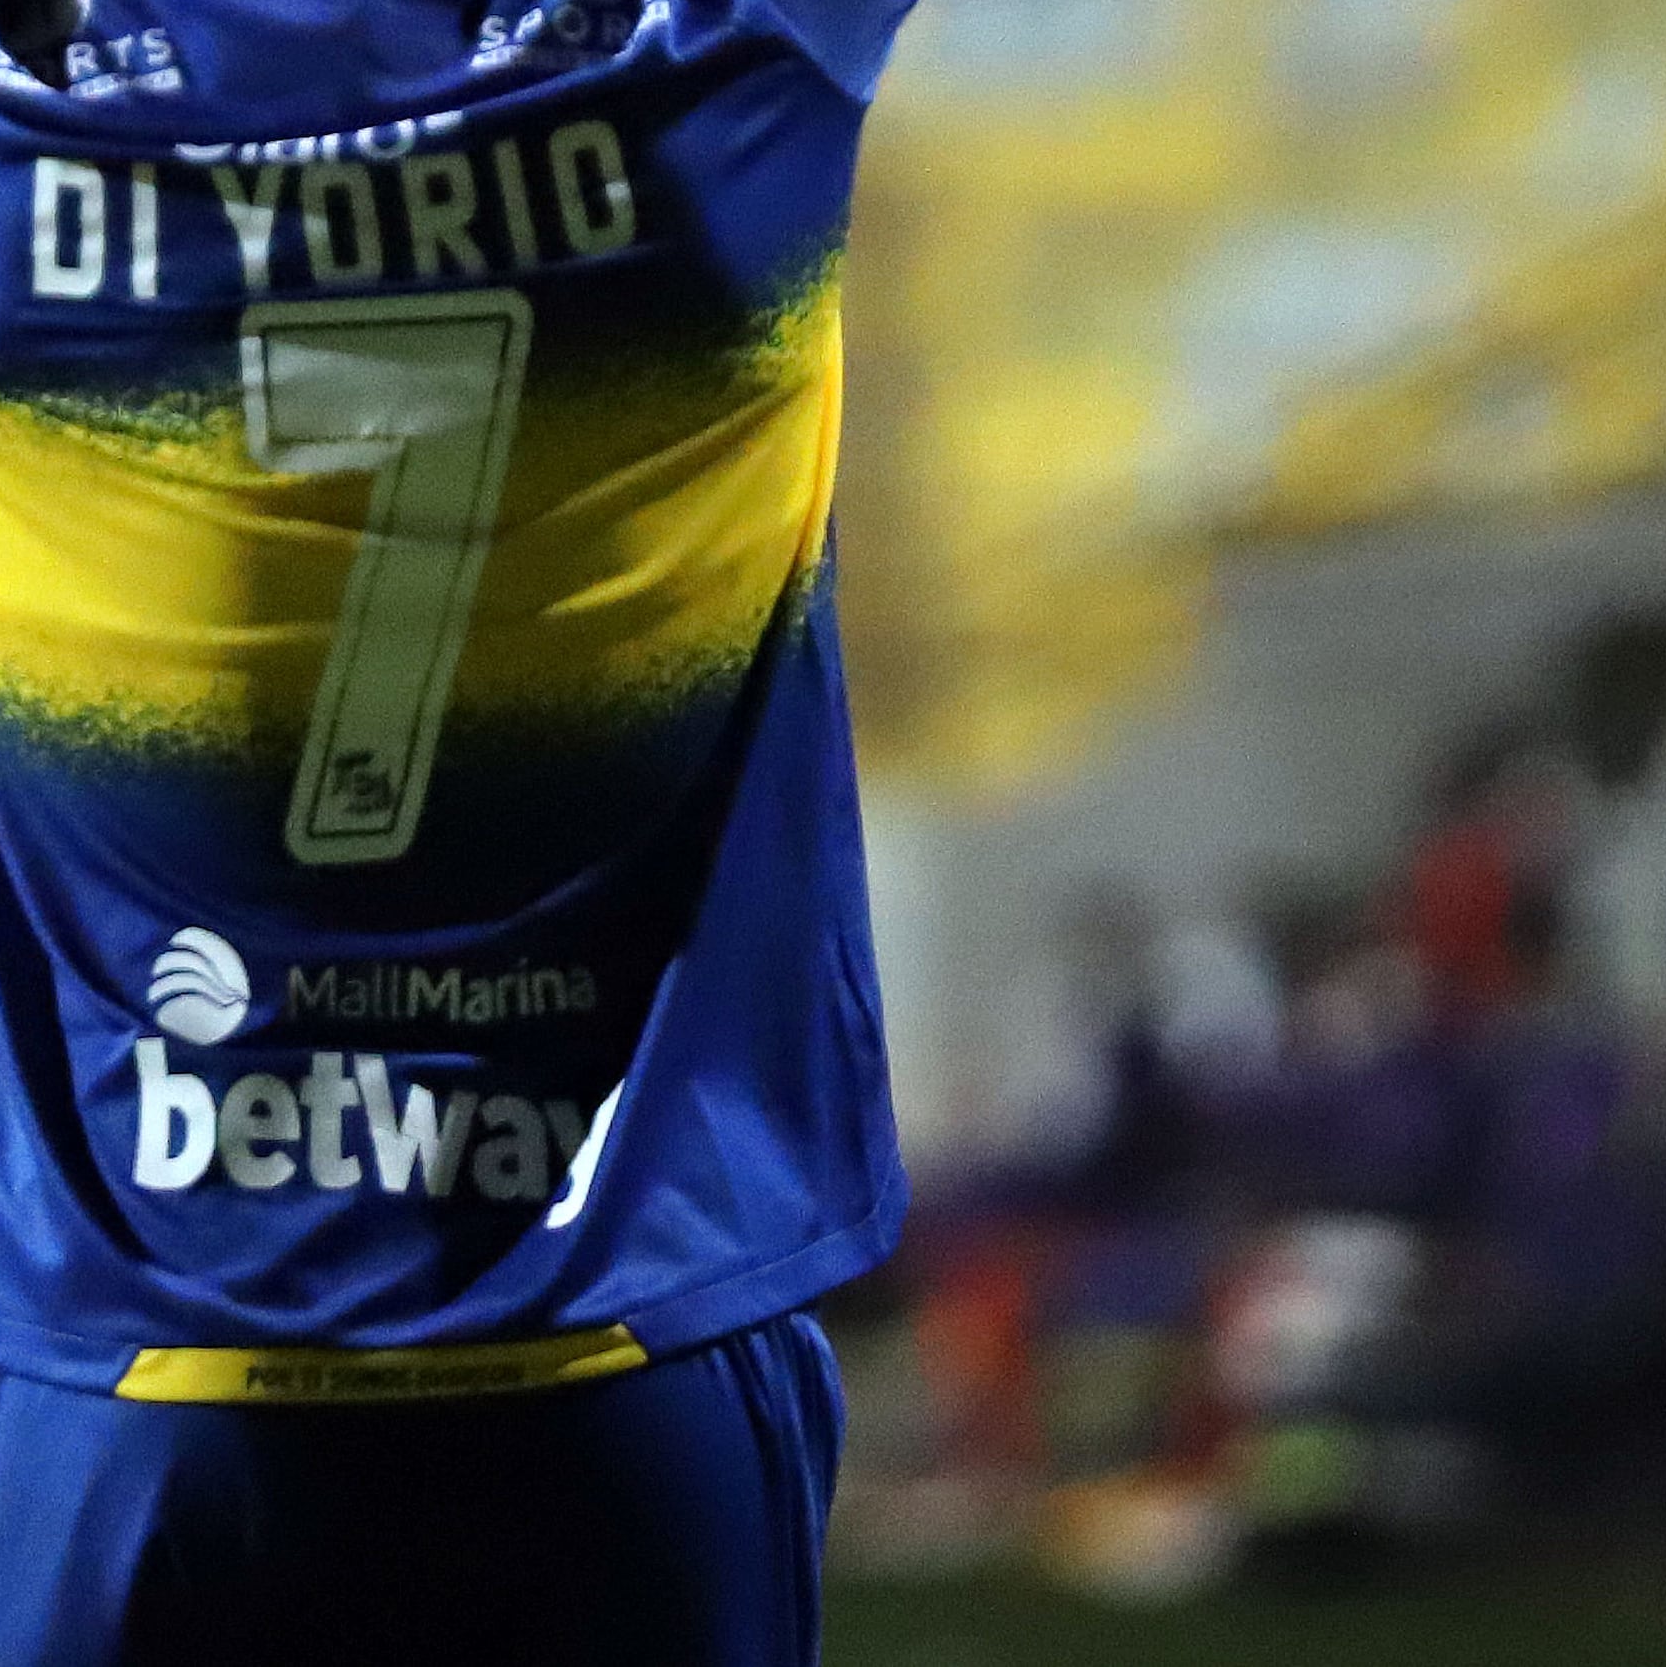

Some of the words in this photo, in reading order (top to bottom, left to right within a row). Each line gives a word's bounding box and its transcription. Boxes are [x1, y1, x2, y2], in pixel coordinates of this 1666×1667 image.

[31, 156, 160, 301] DI
[211, 119, 637, 292] YORIO
[240, 287, 533, 867] 7
[286, 958, 597, 1024] MallMarina
[133, 1035, 625, 1229] betway
